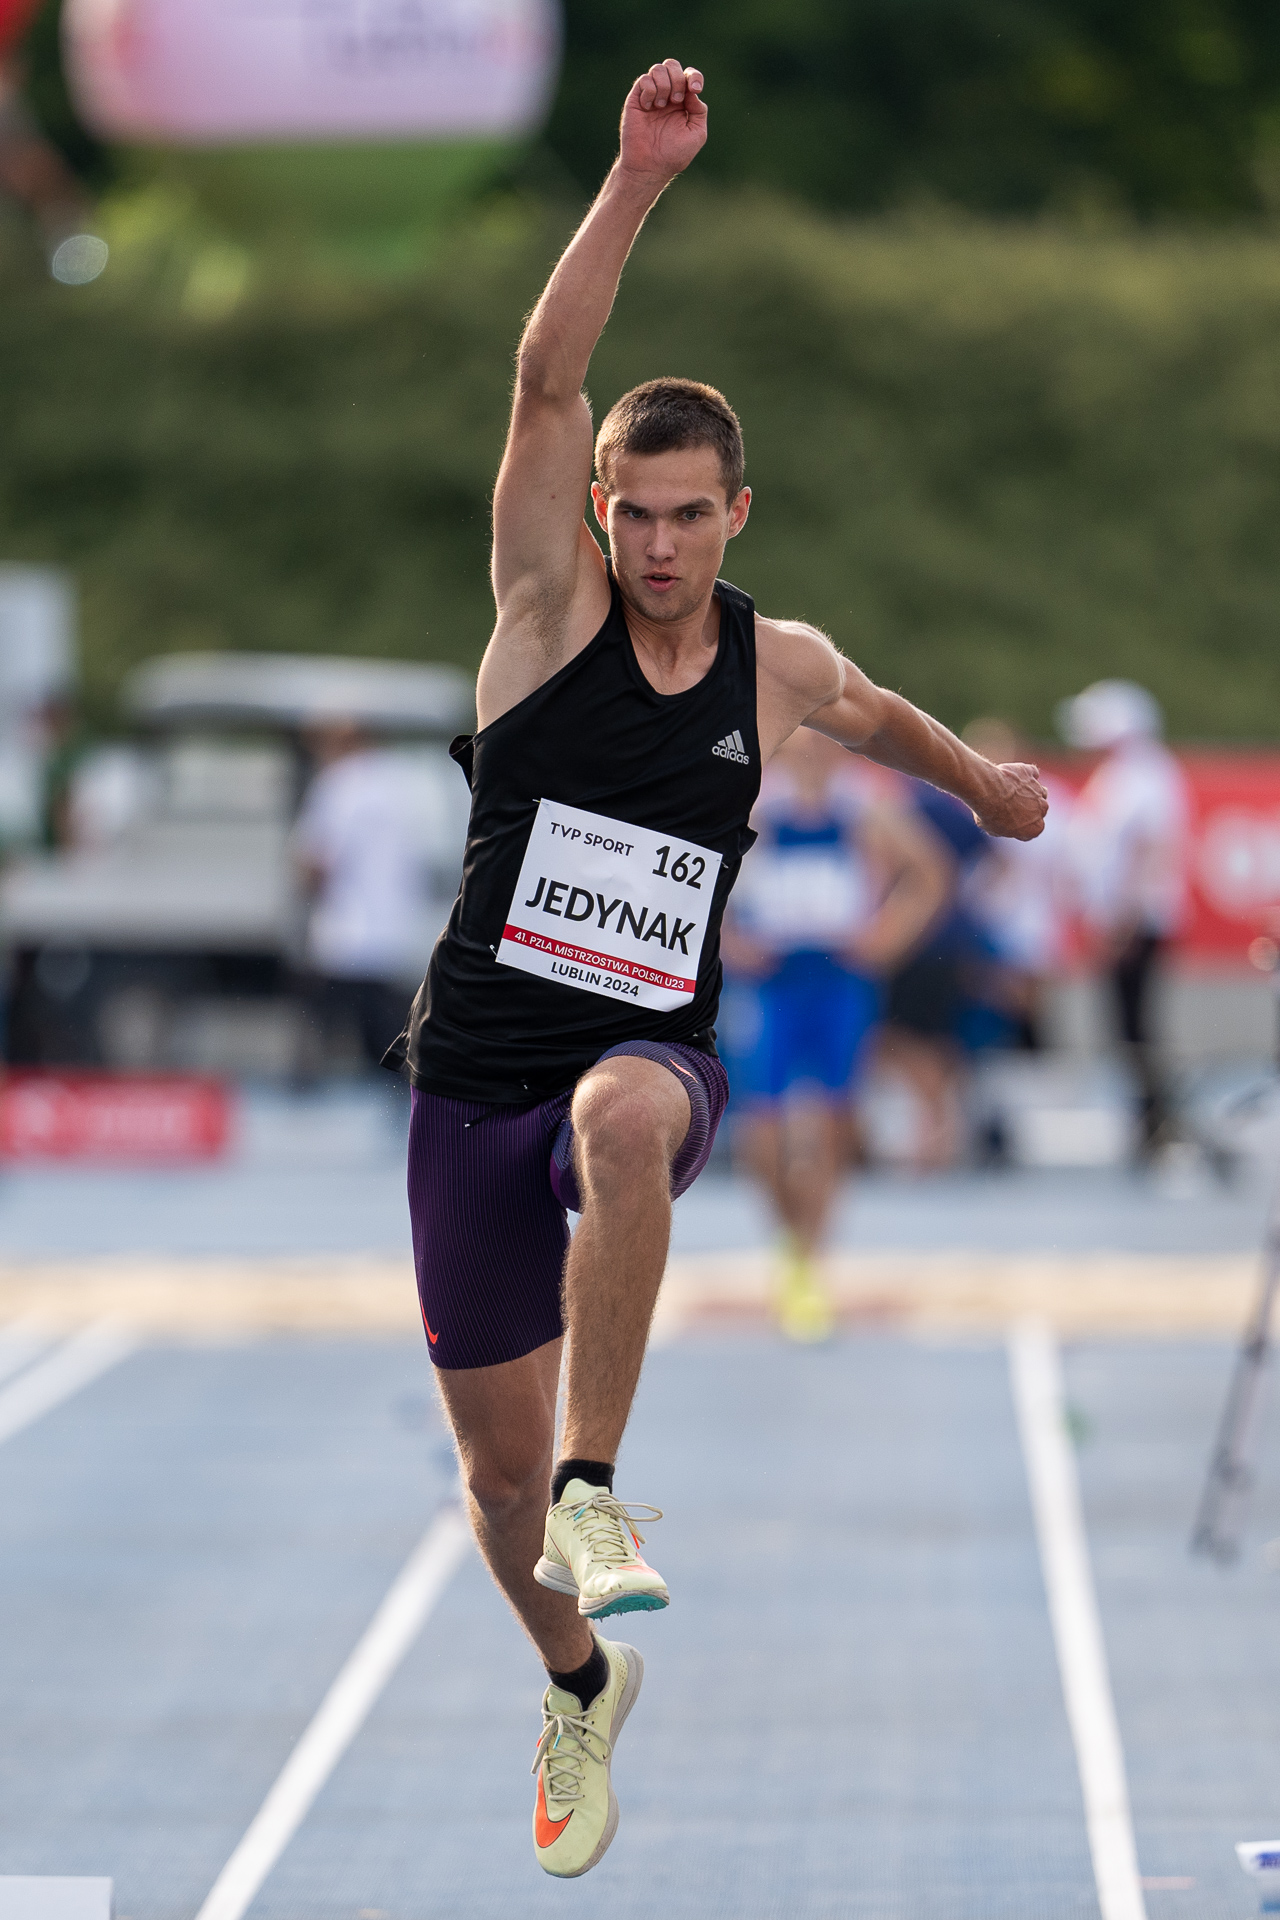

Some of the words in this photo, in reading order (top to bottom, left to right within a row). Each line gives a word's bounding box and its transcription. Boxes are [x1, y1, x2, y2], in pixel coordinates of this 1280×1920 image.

[711, 745, 750, 765] adidas
[550, 822, 581, 841] TVP
[583, 832, 635, 857] SPORT
[652, 845, 706, 890] 162
[525, 876, 697, 956] JEDYNAK
[514, 931, 528, 943] 41.
[529, 935, 552, 952] PZLA
[554, 943, 630, 974] MISTRZOSTWA
[631, 966, 663, 985] POLSKI
[664, 977, 685, 990] U23
[551, 961, 602, 986] LUBLIN
[603, 976, 640, 997] 2024
